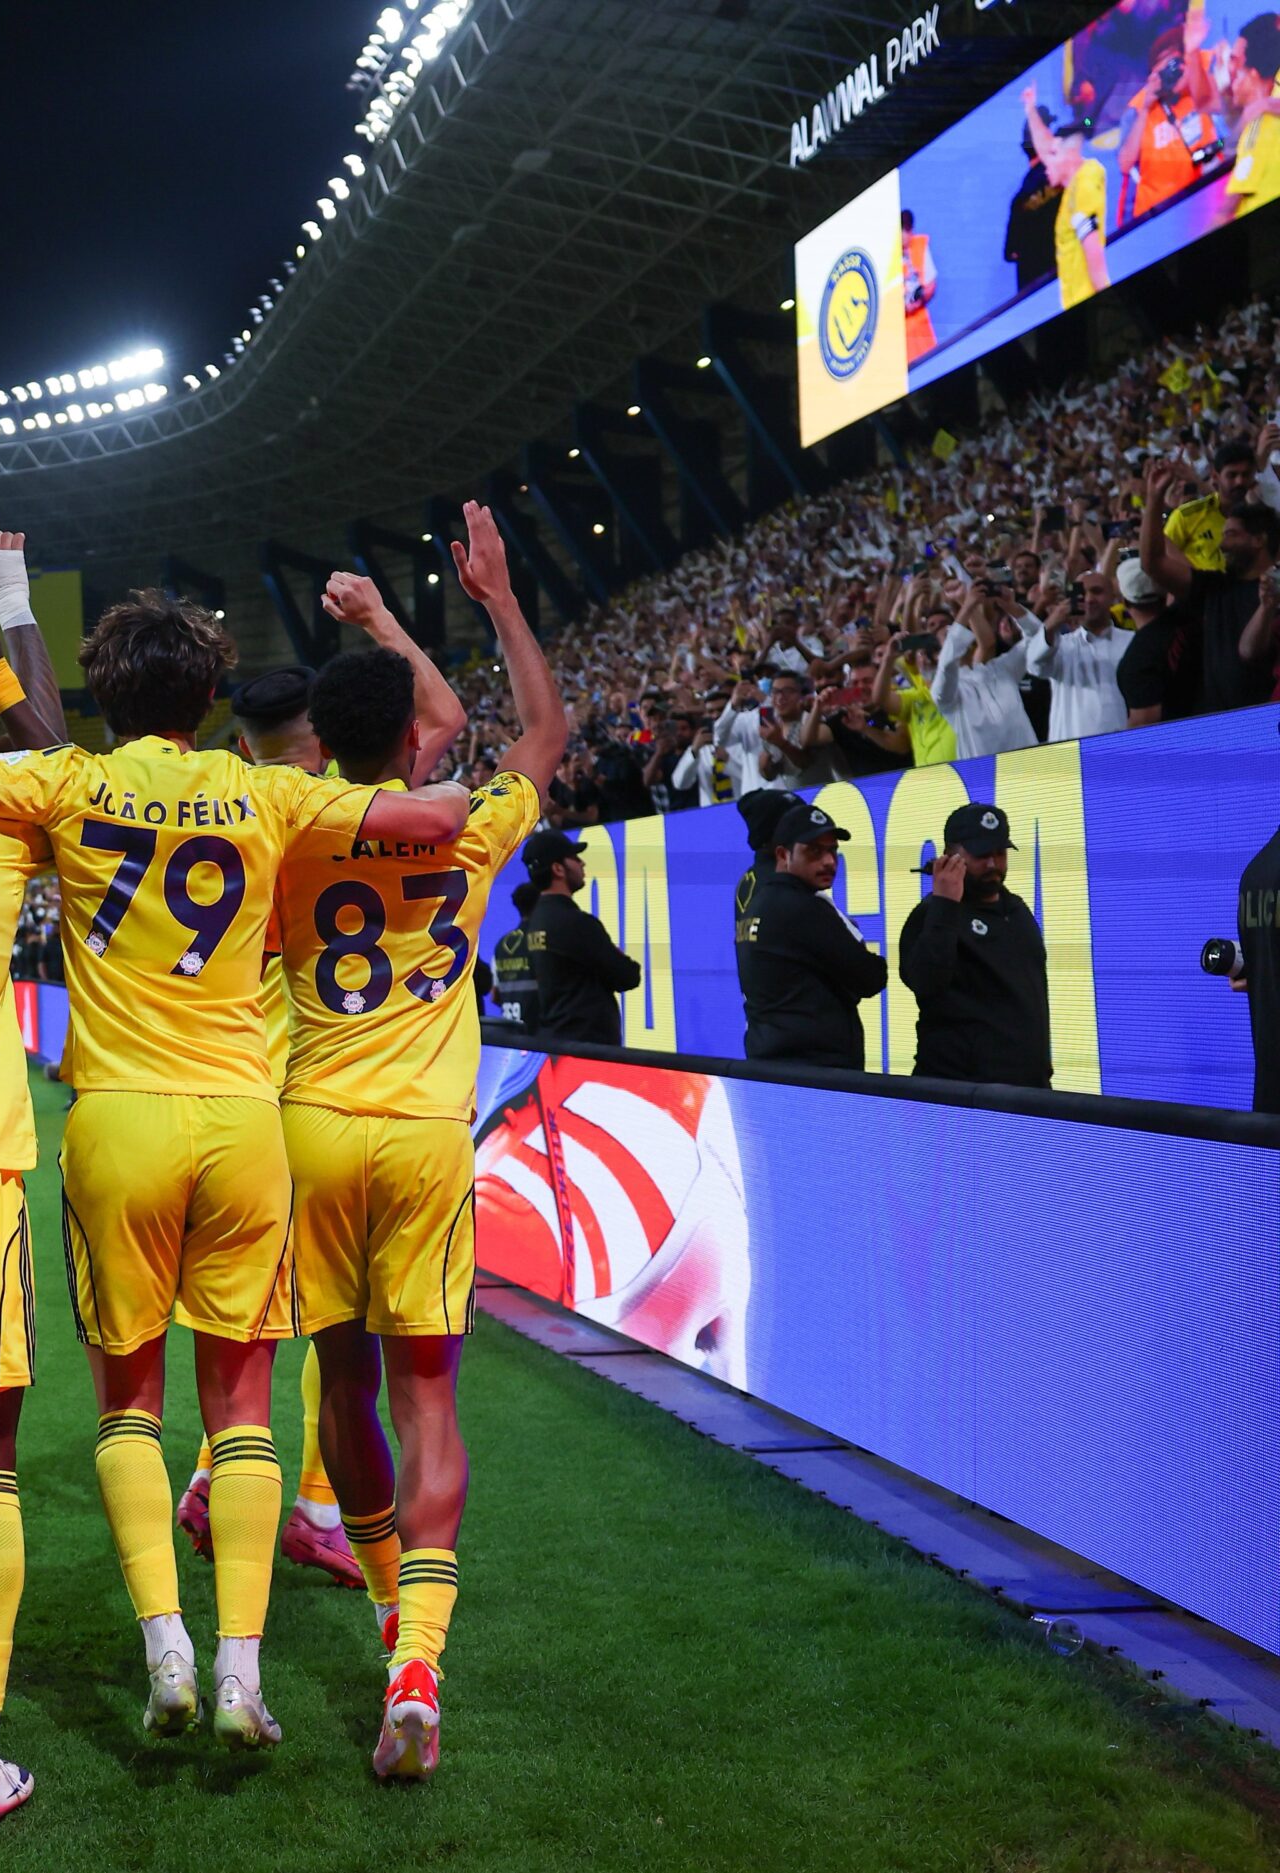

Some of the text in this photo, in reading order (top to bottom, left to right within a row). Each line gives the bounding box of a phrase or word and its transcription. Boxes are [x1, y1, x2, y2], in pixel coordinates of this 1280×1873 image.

[789, 3, 941, 168] ALAWWAL PARK
[89, 782, 257, 827] JOÃO FÉLIX
[80, 818, 246, 977] 79
[314, 869, 470, 1015] 83
